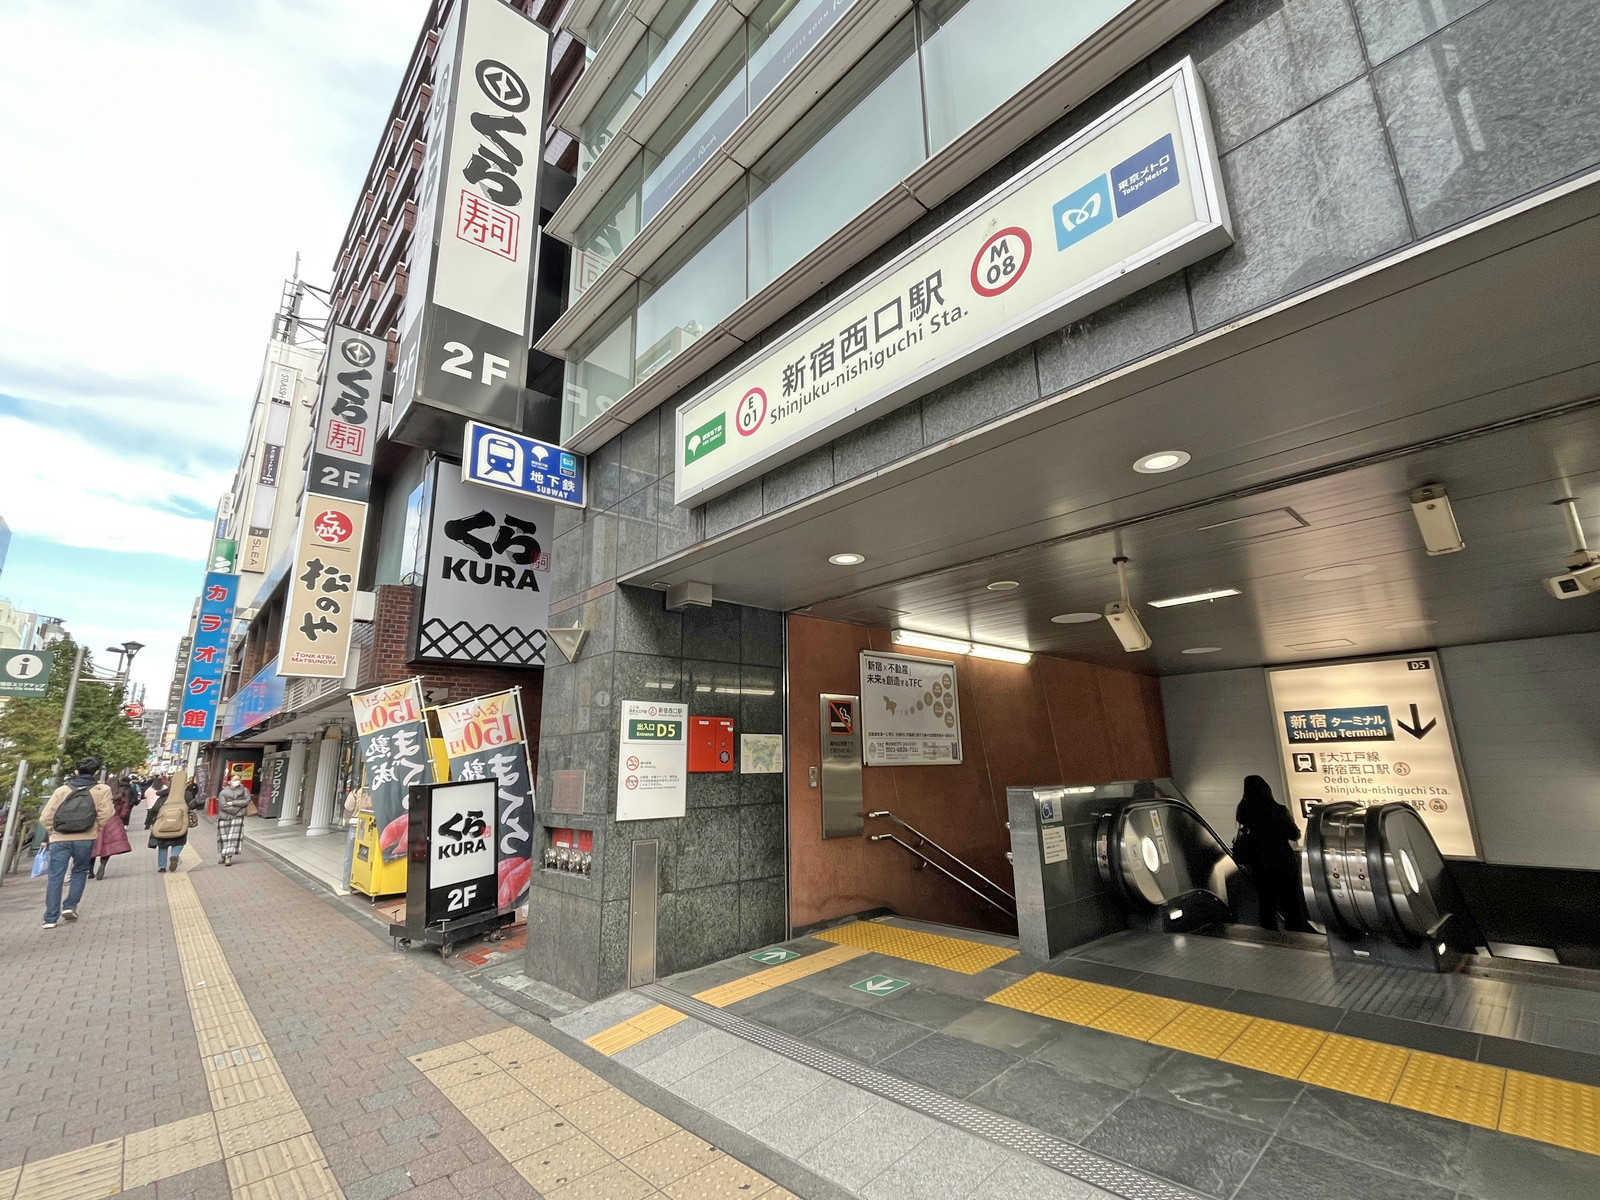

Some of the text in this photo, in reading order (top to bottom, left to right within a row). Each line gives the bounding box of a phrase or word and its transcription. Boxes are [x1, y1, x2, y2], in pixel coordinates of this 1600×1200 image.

[462, 111, 527, 207] くら
[1118, 154, 1170, 191] 東京メトロ
[1122, 166, 1169, 198] Tokyo Metro
[463, 198, 514, 256] 寿司
[989, 239, 1010, 263] M
[986, 255, 1016, 285] 08
[782, 269, 945, 398] 新宿西口駅
[440, 340, 511, 387] 2F
[770, 306, 968, 424] Shinjuku-nishiguchi Sta.
[331, 368, 373, 425] くら
[748, 396, 755, 410] E
[744, 409, 757, 427] 01
[330, 421, 363, 452] 寿司
[319, 466, 362, 489] 2F
[530, 470, 575, 492] 地下鉄
[536, 485, 568, 499] SUBWAY
[443, 509, 541, 566] くら
[442, 556, 540, 593] KURA
[300, 558, 352, 641] 松のや
[182, 585, 228, 728] カラオケ館
[291, 657, 337, 665] MATSUNOYA
[295, 652, 336, 660] TONKATSU
[1411, 661, 1426, 670] D5
[636, 723, 655, 731] 出入口
[656, 723, 676, 737] D5
[1293, 727, 1388, 741] Shinjuku Terminal
[1321, 764, 1391, 775] 新宿西口駅
[1324, 776, 1373, 784] Oedo Line
[1324, 785, 1451, 796] Shinjuku-nishiguchi Sta.
[438, 810, 487, 841] くら
[438, 838, 487, 860] KURA
[447, 884, 478, 912] 2F
